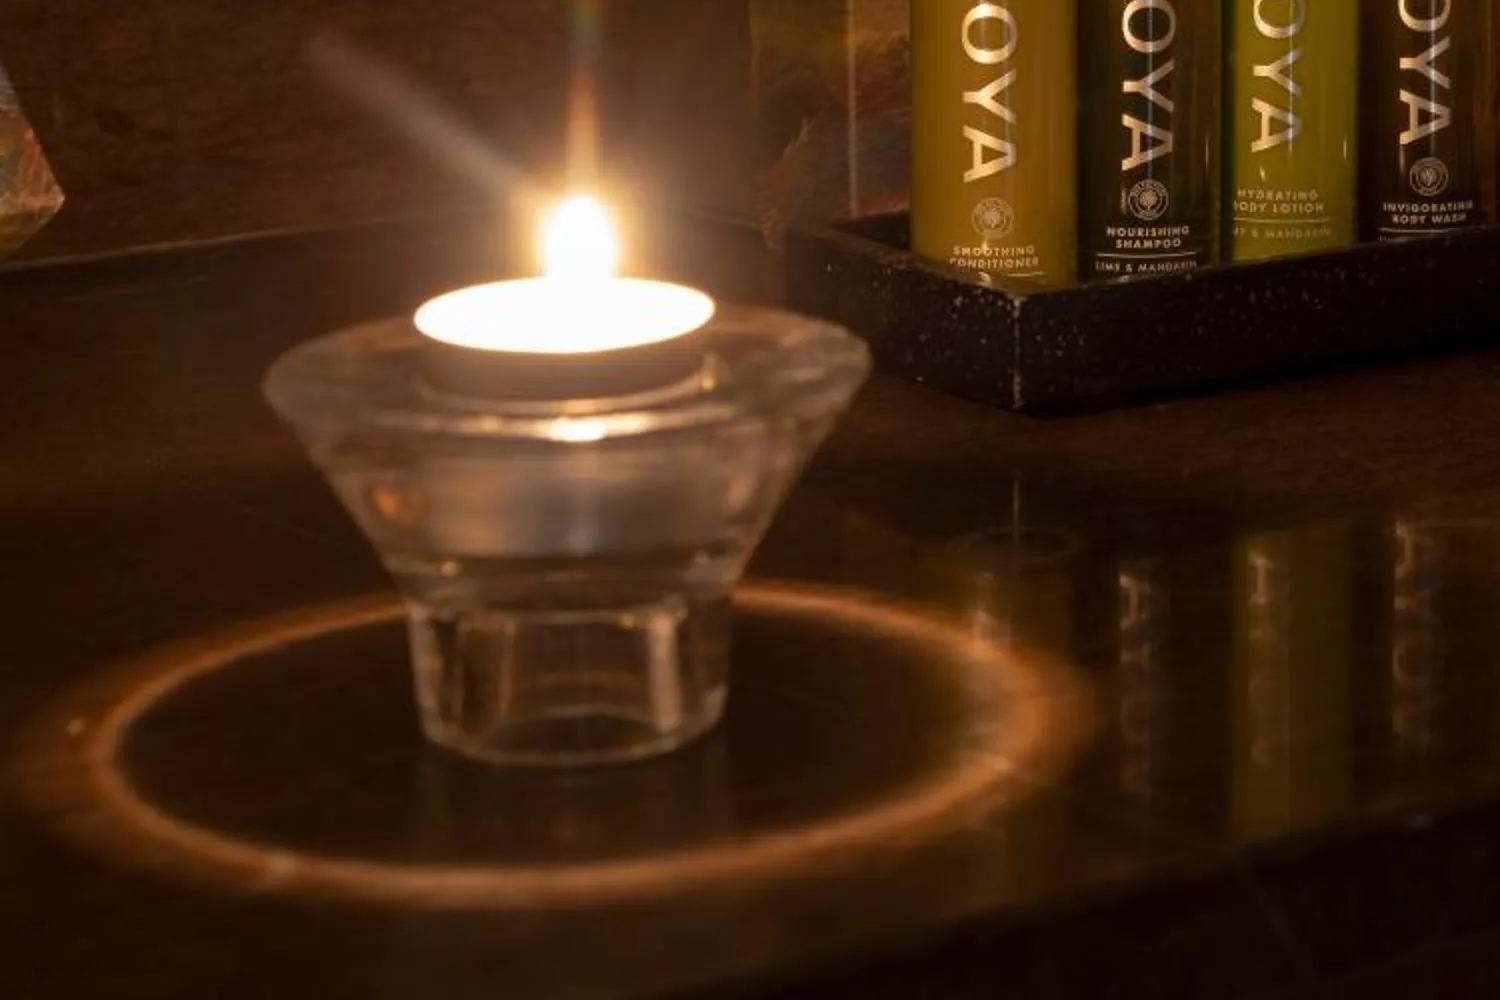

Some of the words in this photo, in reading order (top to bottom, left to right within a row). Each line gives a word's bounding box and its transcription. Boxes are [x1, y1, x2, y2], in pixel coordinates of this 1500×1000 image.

[1237, 189, 1319, 201] HYDRATING
[1273, 202, 1325, 214] LOTION
[1383, 200, 1473, 213] INVIGORATING
[1391, 214, 1427, 225] BODY
[1106, 225, 1190, 237] NOURISHING
[1116, 238, 1181, 249] SHAMPOO
[953, 245, 1035, 257] SMOOTHING
